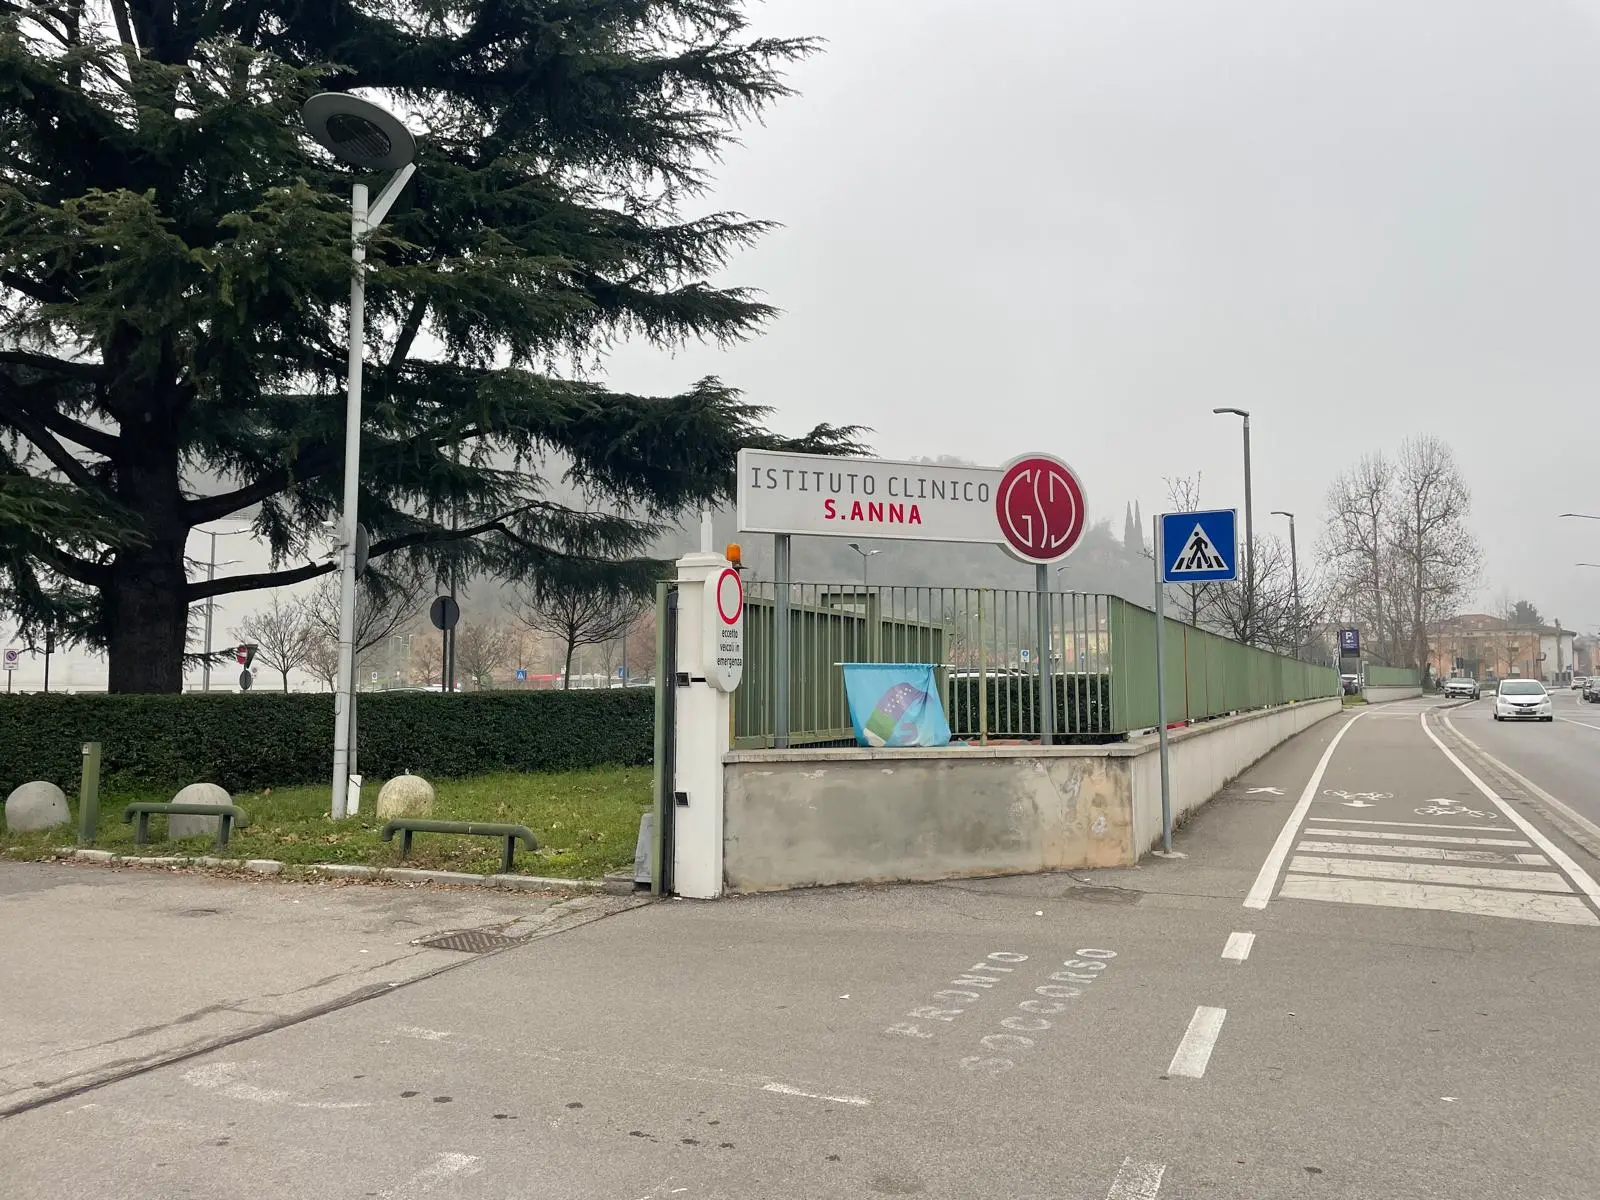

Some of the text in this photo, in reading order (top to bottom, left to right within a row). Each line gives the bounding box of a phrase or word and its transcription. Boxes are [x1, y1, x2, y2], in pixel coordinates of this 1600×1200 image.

[751, 467, 989, 502] ISTITUTO CLINICO
[824, 498, 922, 525] S.ANNA
[721, 629, 738, 638] eccetto
[1346, 632, 1352, 640] P
[720, 641, 734, 652] veicoli
[717, 657, 742, 668] emergenza
[885, 951, 1029, 1039] PRONTO
[958, 948, 1118, 1073] SOCCORSO
